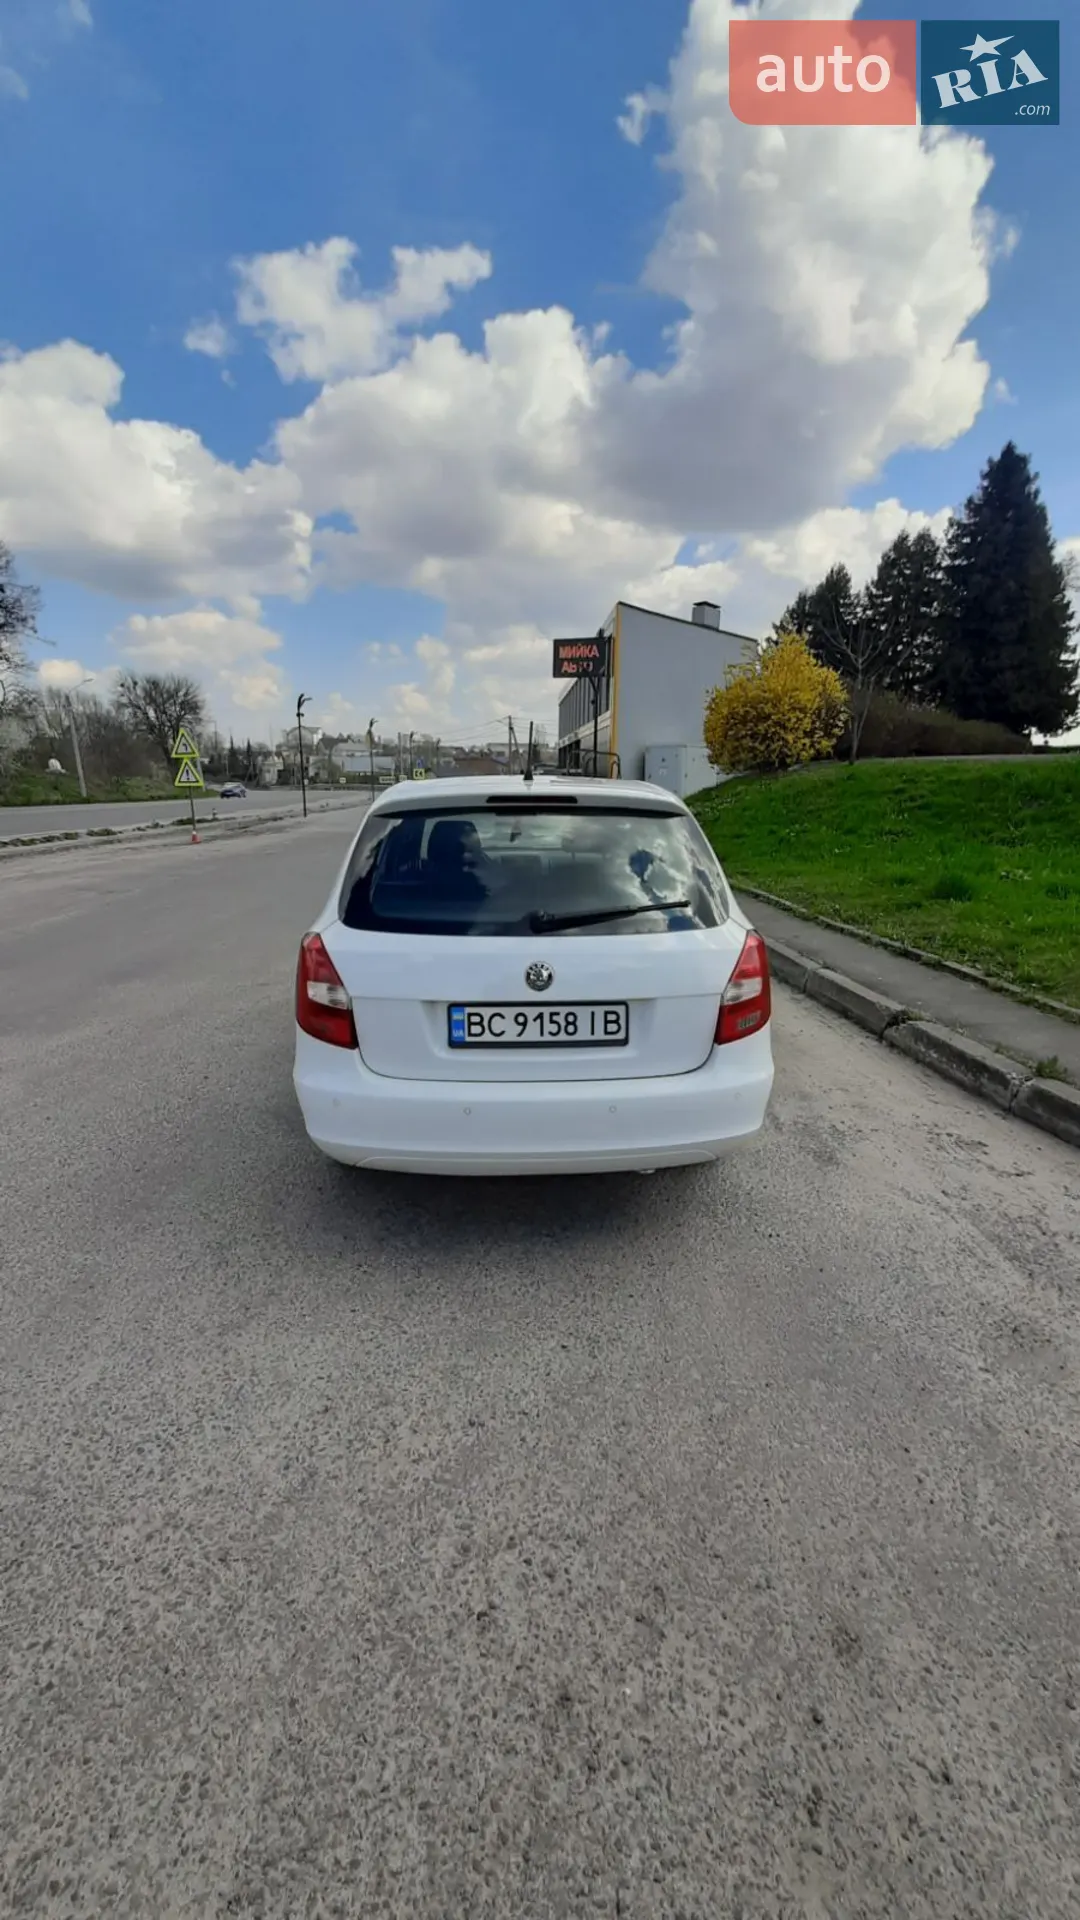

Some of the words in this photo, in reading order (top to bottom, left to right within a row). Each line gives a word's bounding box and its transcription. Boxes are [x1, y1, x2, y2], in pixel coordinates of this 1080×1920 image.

[467, 1012, 506, 1037] BC
[514, 1012, 578, 1037] 9158
[590, 1010, 622, 1035] IB
